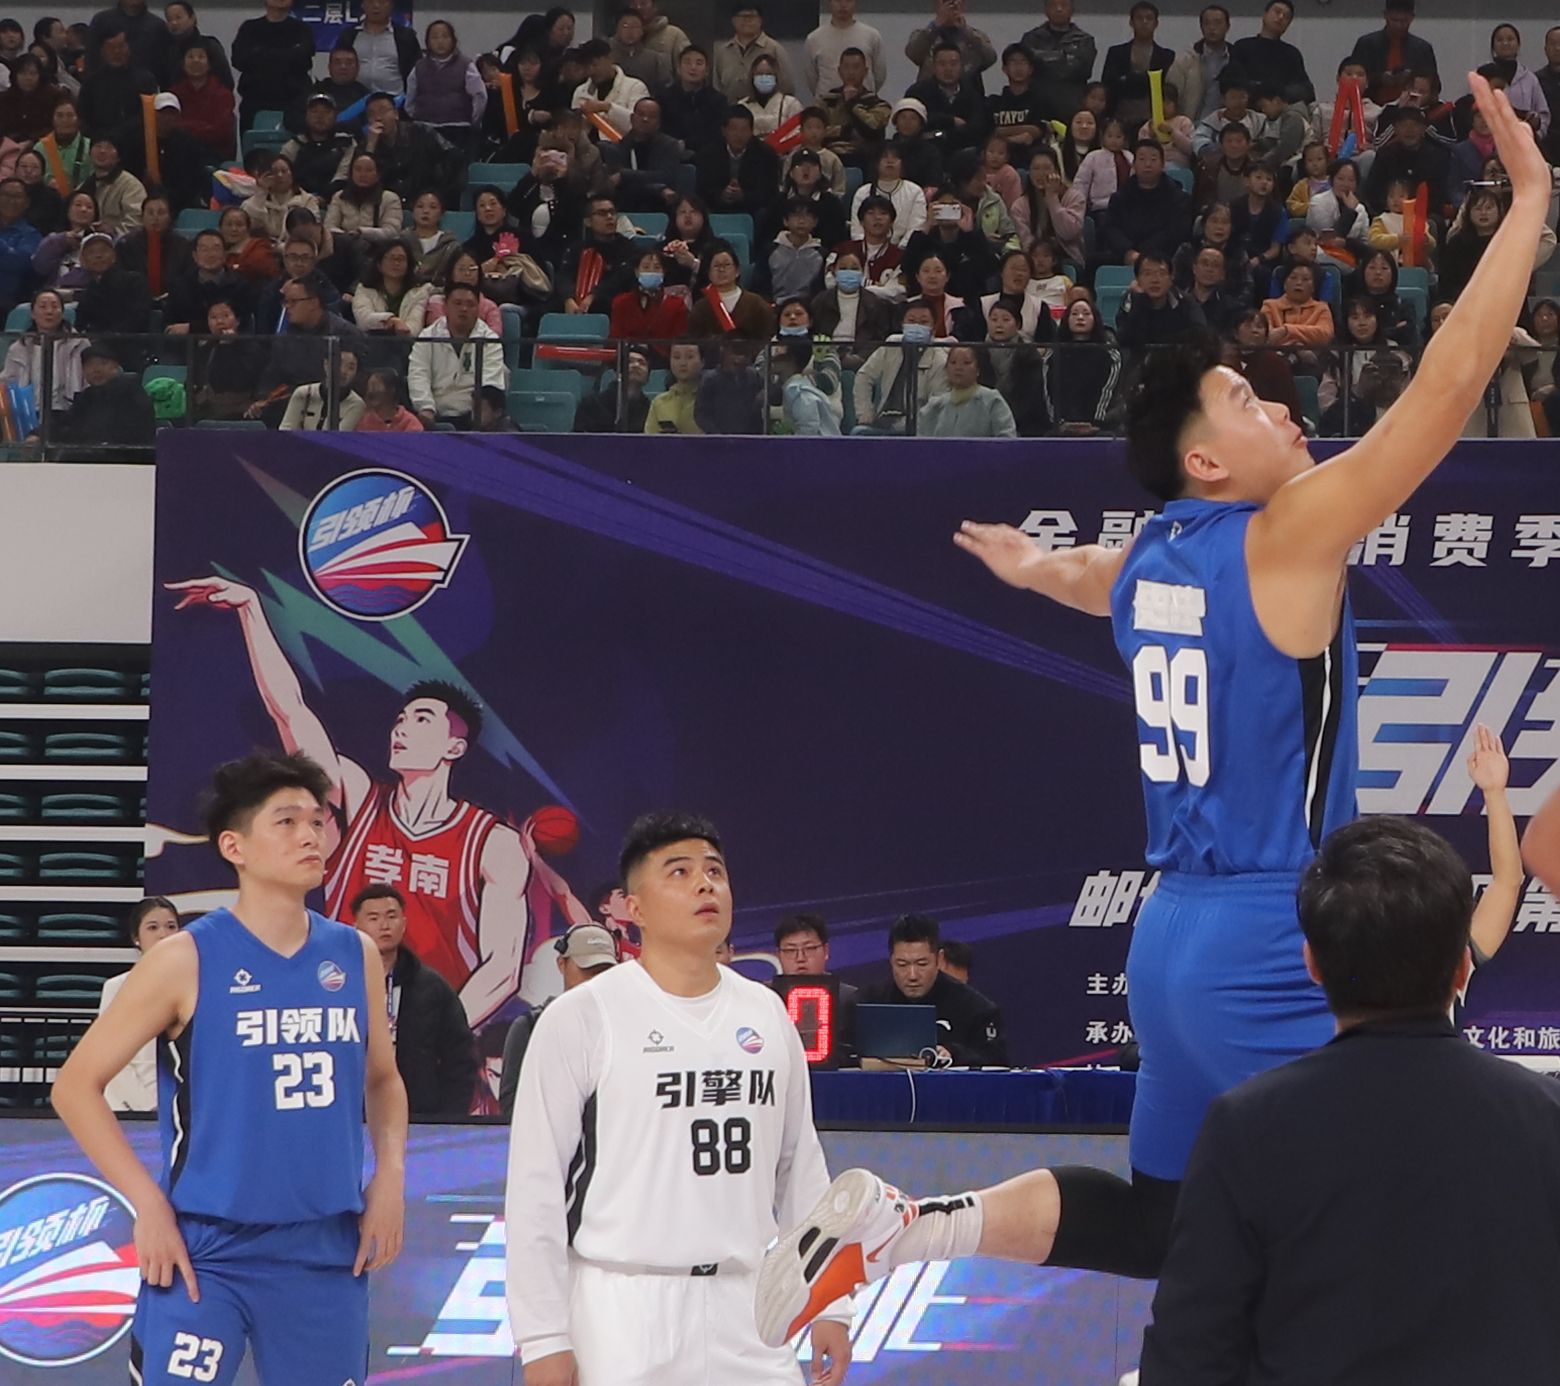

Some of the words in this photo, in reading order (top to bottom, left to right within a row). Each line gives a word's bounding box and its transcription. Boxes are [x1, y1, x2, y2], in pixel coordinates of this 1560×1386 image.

[1133, 644, 1211, 788] 99
[236, 1006, 361, 1047] 引领队
[272, 1051, 336, 1110] 23
[655, 1069, 776, 1110] 引擎队
[691, 1116, 752, 1177] 88
[167, 1331, 224, 1384] 23
